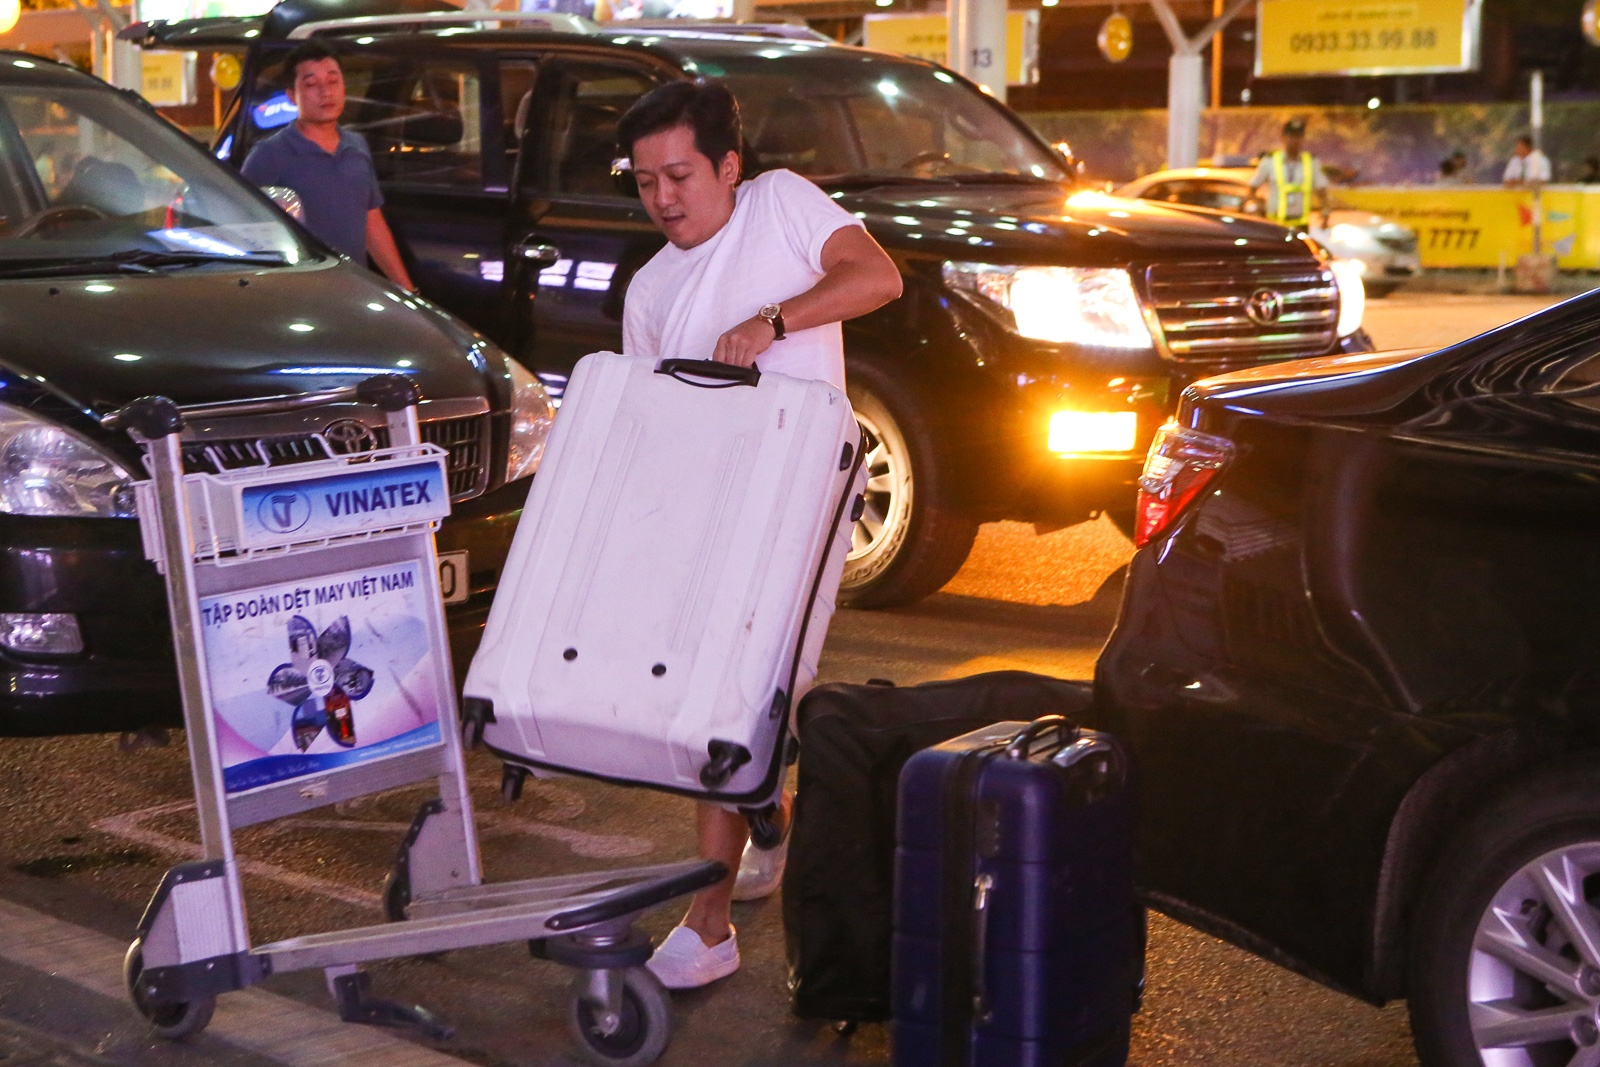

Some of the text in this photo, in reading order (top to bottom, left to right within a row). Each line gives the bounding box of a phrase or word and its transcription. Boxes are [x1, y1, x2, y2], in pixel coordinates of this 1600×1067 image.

[971, 48, 993, 68] 13
[1429, 228, 1480, 250] 7777
[325, 479, 432, 518] VINATEX
[202, 569, 415, 629] TẬP ĐOÀN DỆT MAY VIỆT NAM
